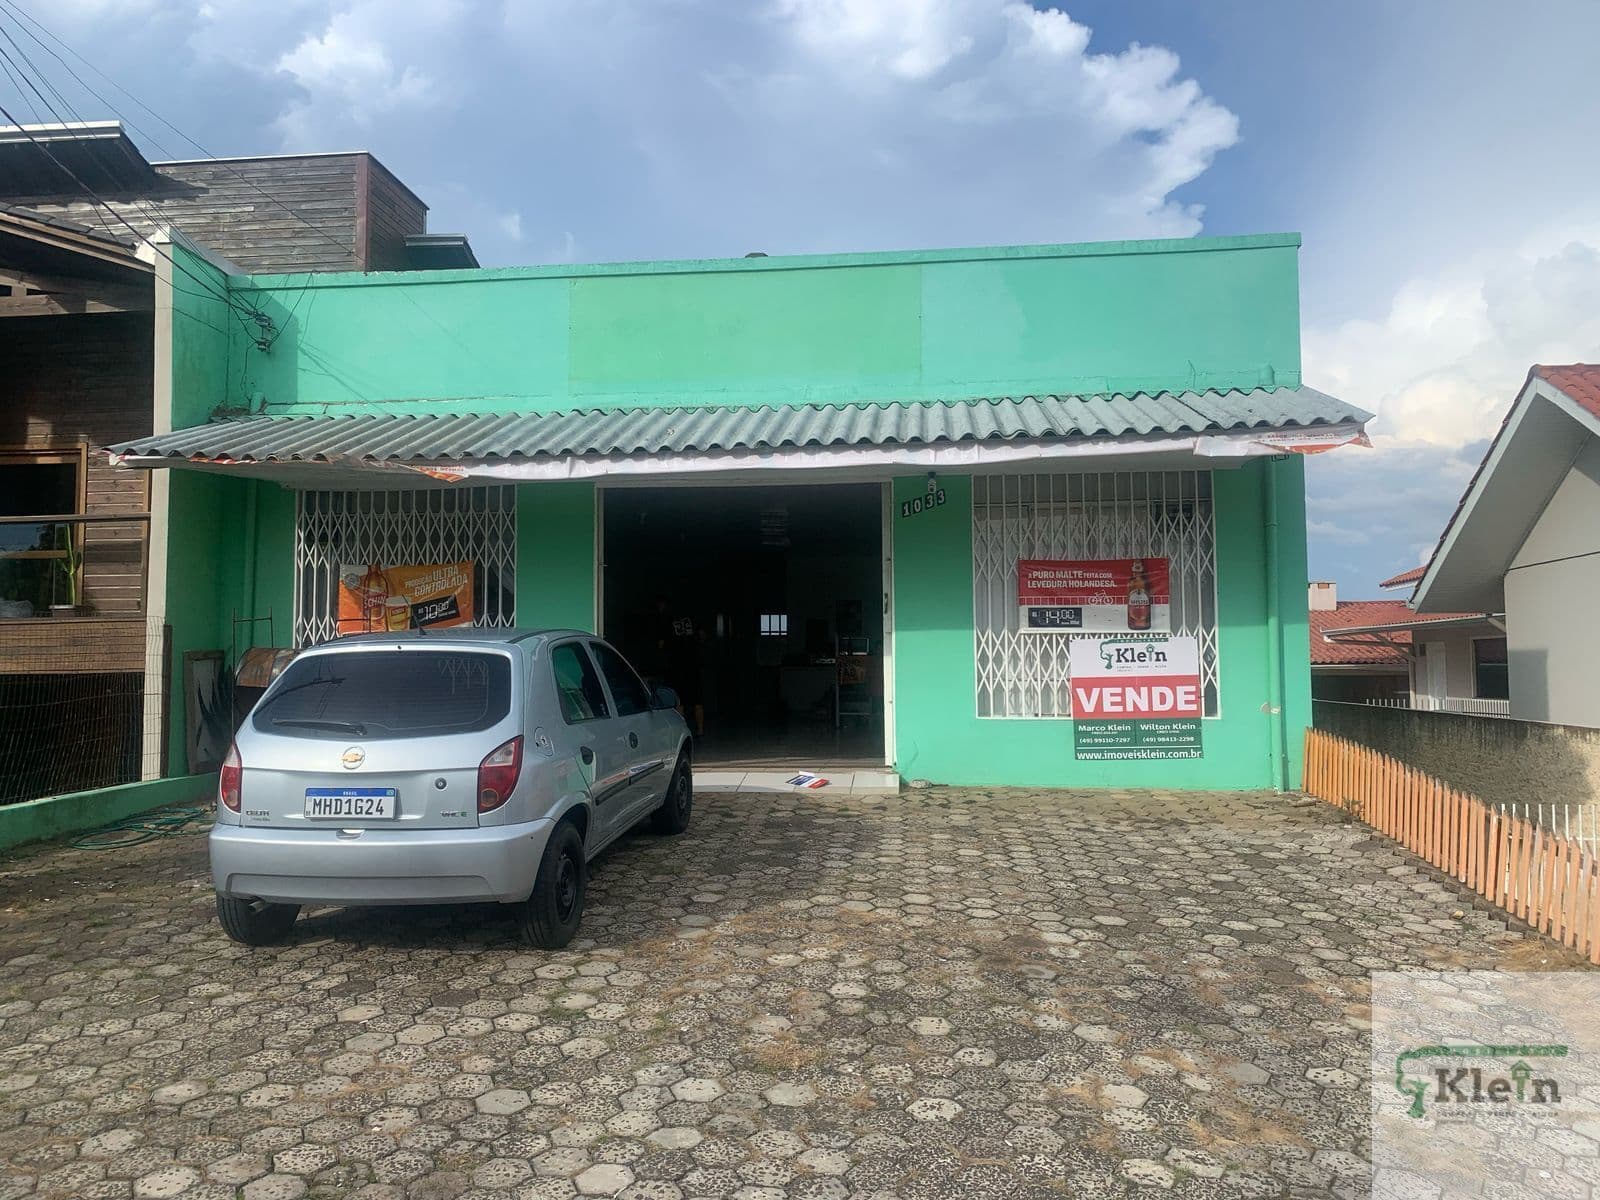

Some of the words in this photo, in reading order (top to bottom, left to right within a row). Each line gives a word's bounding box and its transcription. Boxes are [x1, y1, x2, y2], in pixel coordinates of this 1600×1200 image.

[902, 489, 946, 517] 1033
[432, 565, 459, 581] ULTRA
[1032, 570, 1055, 579] PURO
[1055, 570, 1084, 579] MALTE
[414, 573, 468, 597] CONTROLADA
[1027, 580, 1068, 588] LEVEDURA
[1115, 644, 1168, 663] Klein
[1076, 685, 1198, 713] VENDE
[1077, 749, 1202, 760] www.imoveisklein.com.br
[312, 798, 384, 815] MHD1G24
